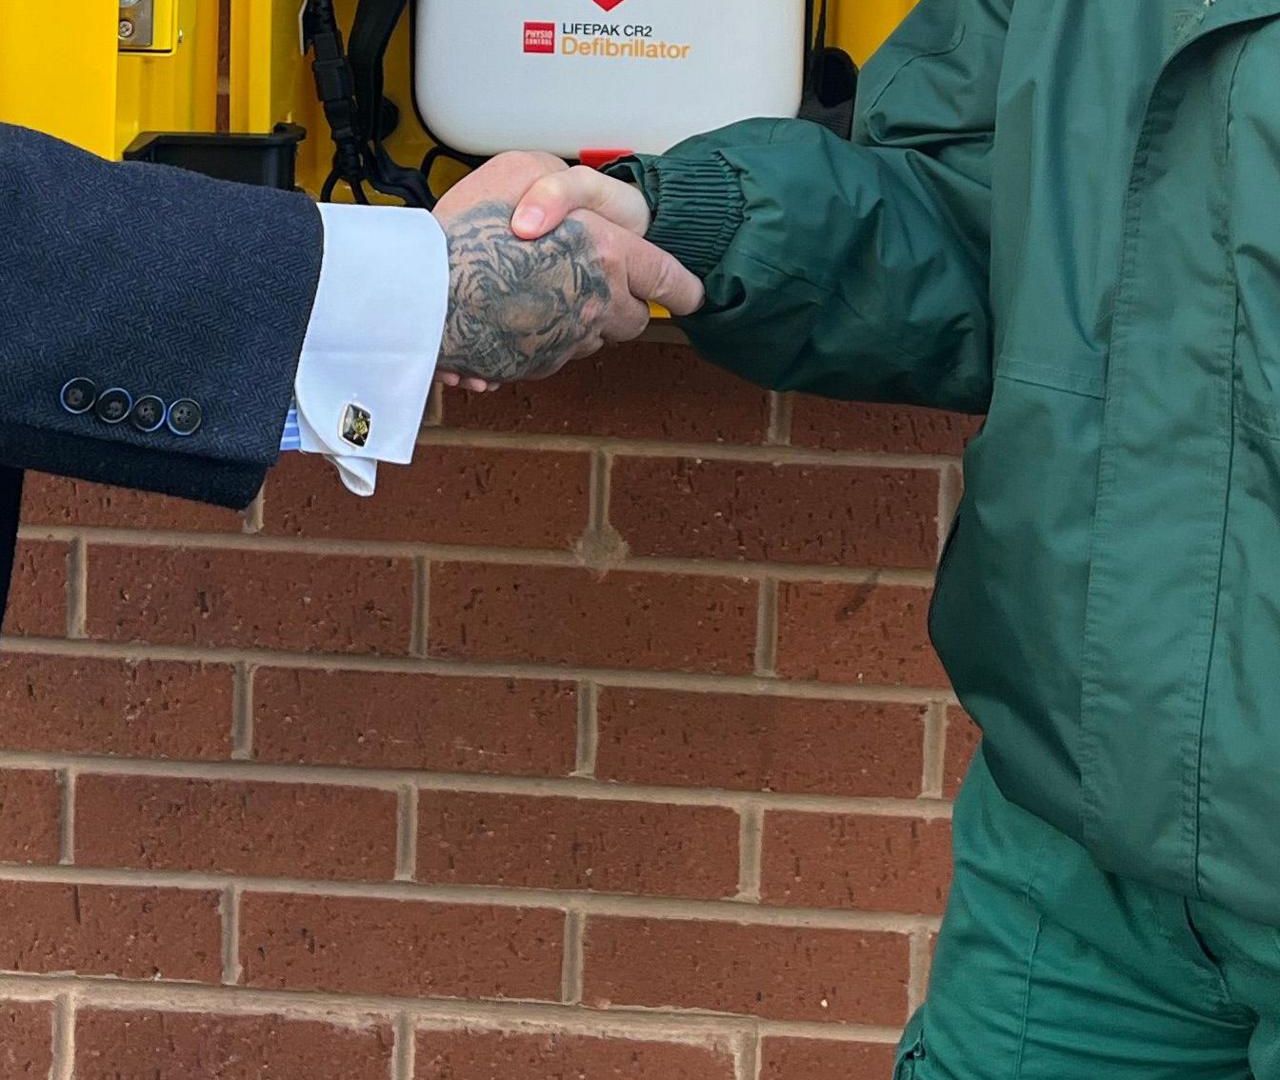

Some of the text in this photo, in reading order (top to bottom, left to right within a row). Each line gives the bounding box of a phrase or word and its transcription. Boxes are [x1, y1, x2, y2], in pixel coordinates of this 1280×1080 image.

[562, 22, 653, 37] LIFEPAK CR2
[561, 36, 691, 59] Defibrillator
